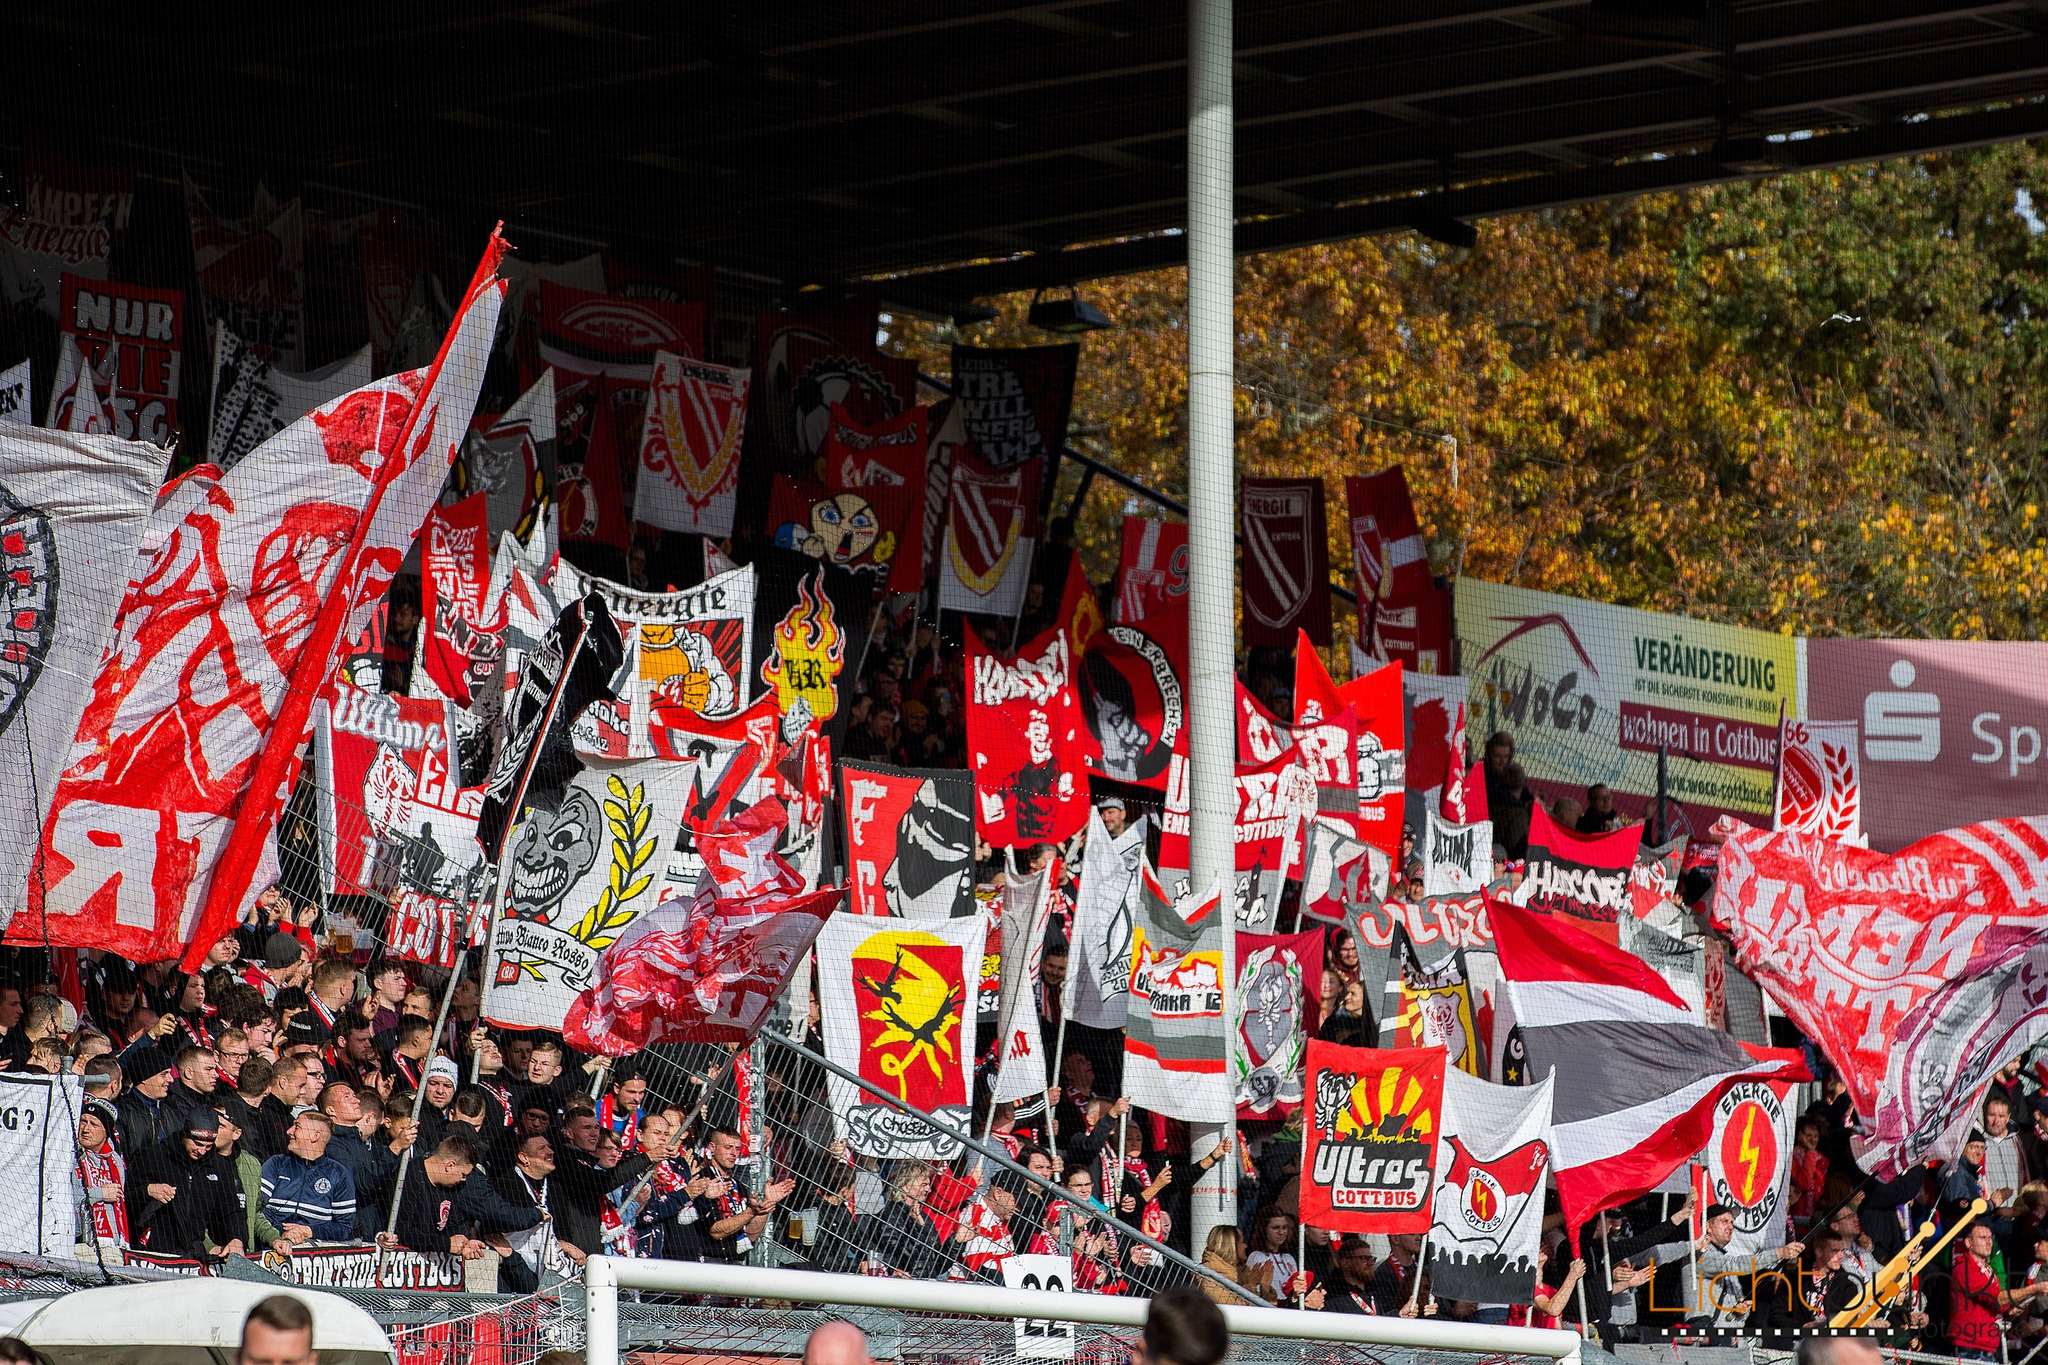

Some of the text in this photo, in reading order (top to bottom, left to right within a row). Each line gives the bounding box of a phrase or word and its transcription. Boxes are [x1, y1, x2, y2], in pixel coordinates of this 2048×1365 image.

[75, 289, 174, 343] NUR
[1635, 633, 1776, 692] VERÄNDERUNG
[1634, 678, 1777, 715] IST DIE SICHERSTE KONSTANTE IM LEBEN
[1623, 710, 1778, 766] wohnen in Cottbus
[1971, 712, 2042, 777] Sp
[516, 924, 549, 953] Bianco
[551, 937, 589, 970] Rosso
[1720, 1082, 1781, 1124] ENERGIE
[1313, 1143, 1432, 1192] Ultras
[1336, 1190, 1417, 1206] COTTBUS
[1715, 1177, 1777, 1229] COTBUS
[292, 1251, 465, 1290] FRONTSIDE COTTBUS
